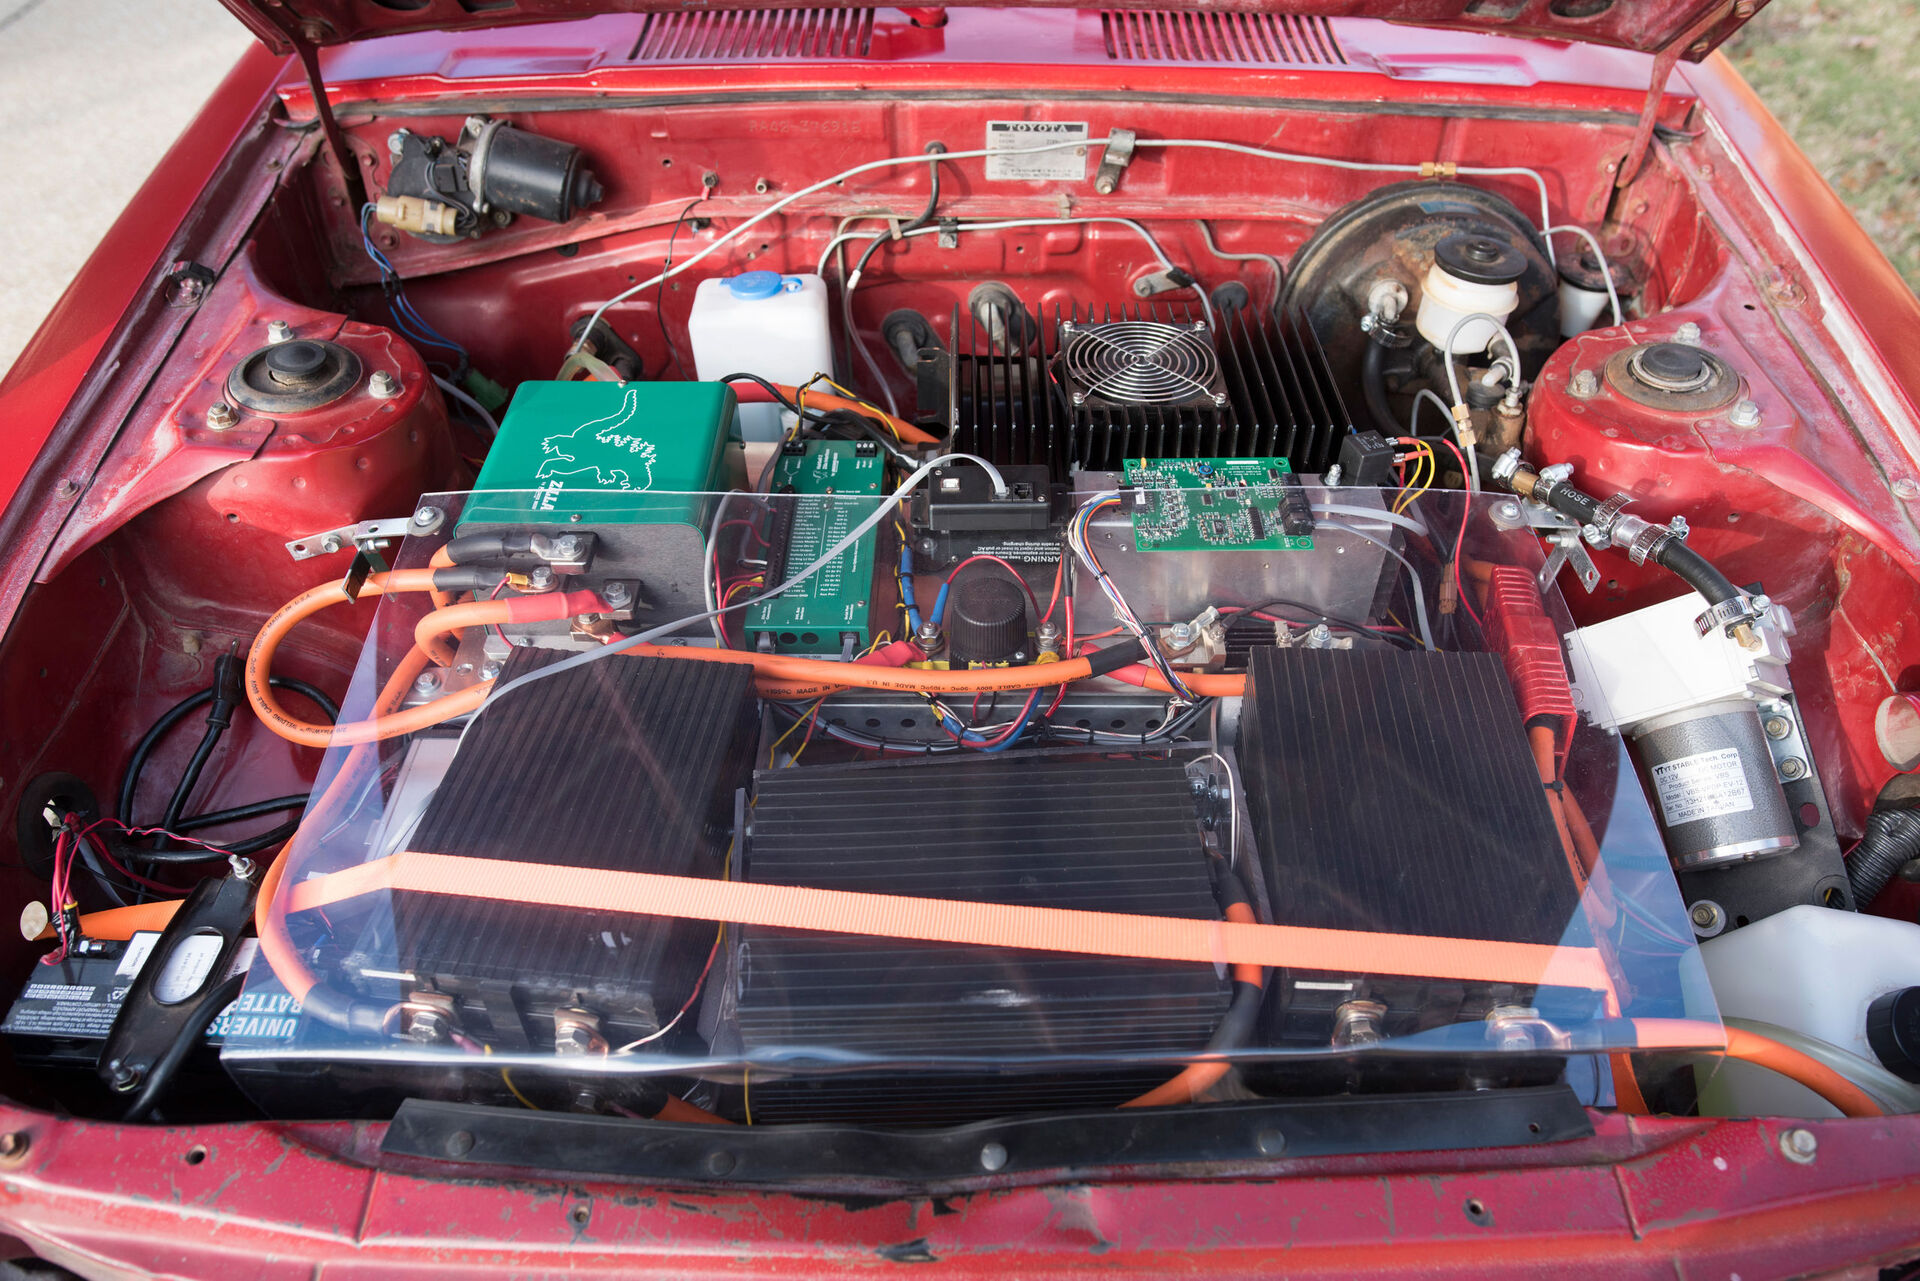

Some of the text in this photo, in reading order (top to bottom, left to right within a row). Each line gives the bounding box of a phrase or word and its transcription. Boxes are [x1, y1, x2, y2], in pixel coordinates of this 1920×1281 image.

[1006, 124, 1068, 132] TOYOTA
[540, 480, 564, 510] ZILLA
[1560, 488, 1590, 506] HOSE
[267, 613, 282, 629] MADE
[1710, 761, 1737, 769] MOTOR
[1678, 809, 1696, 818] MADE
[219, 994, 303, 1016] BATTER
[206, 1016, 296, 1036] UNIVERS
